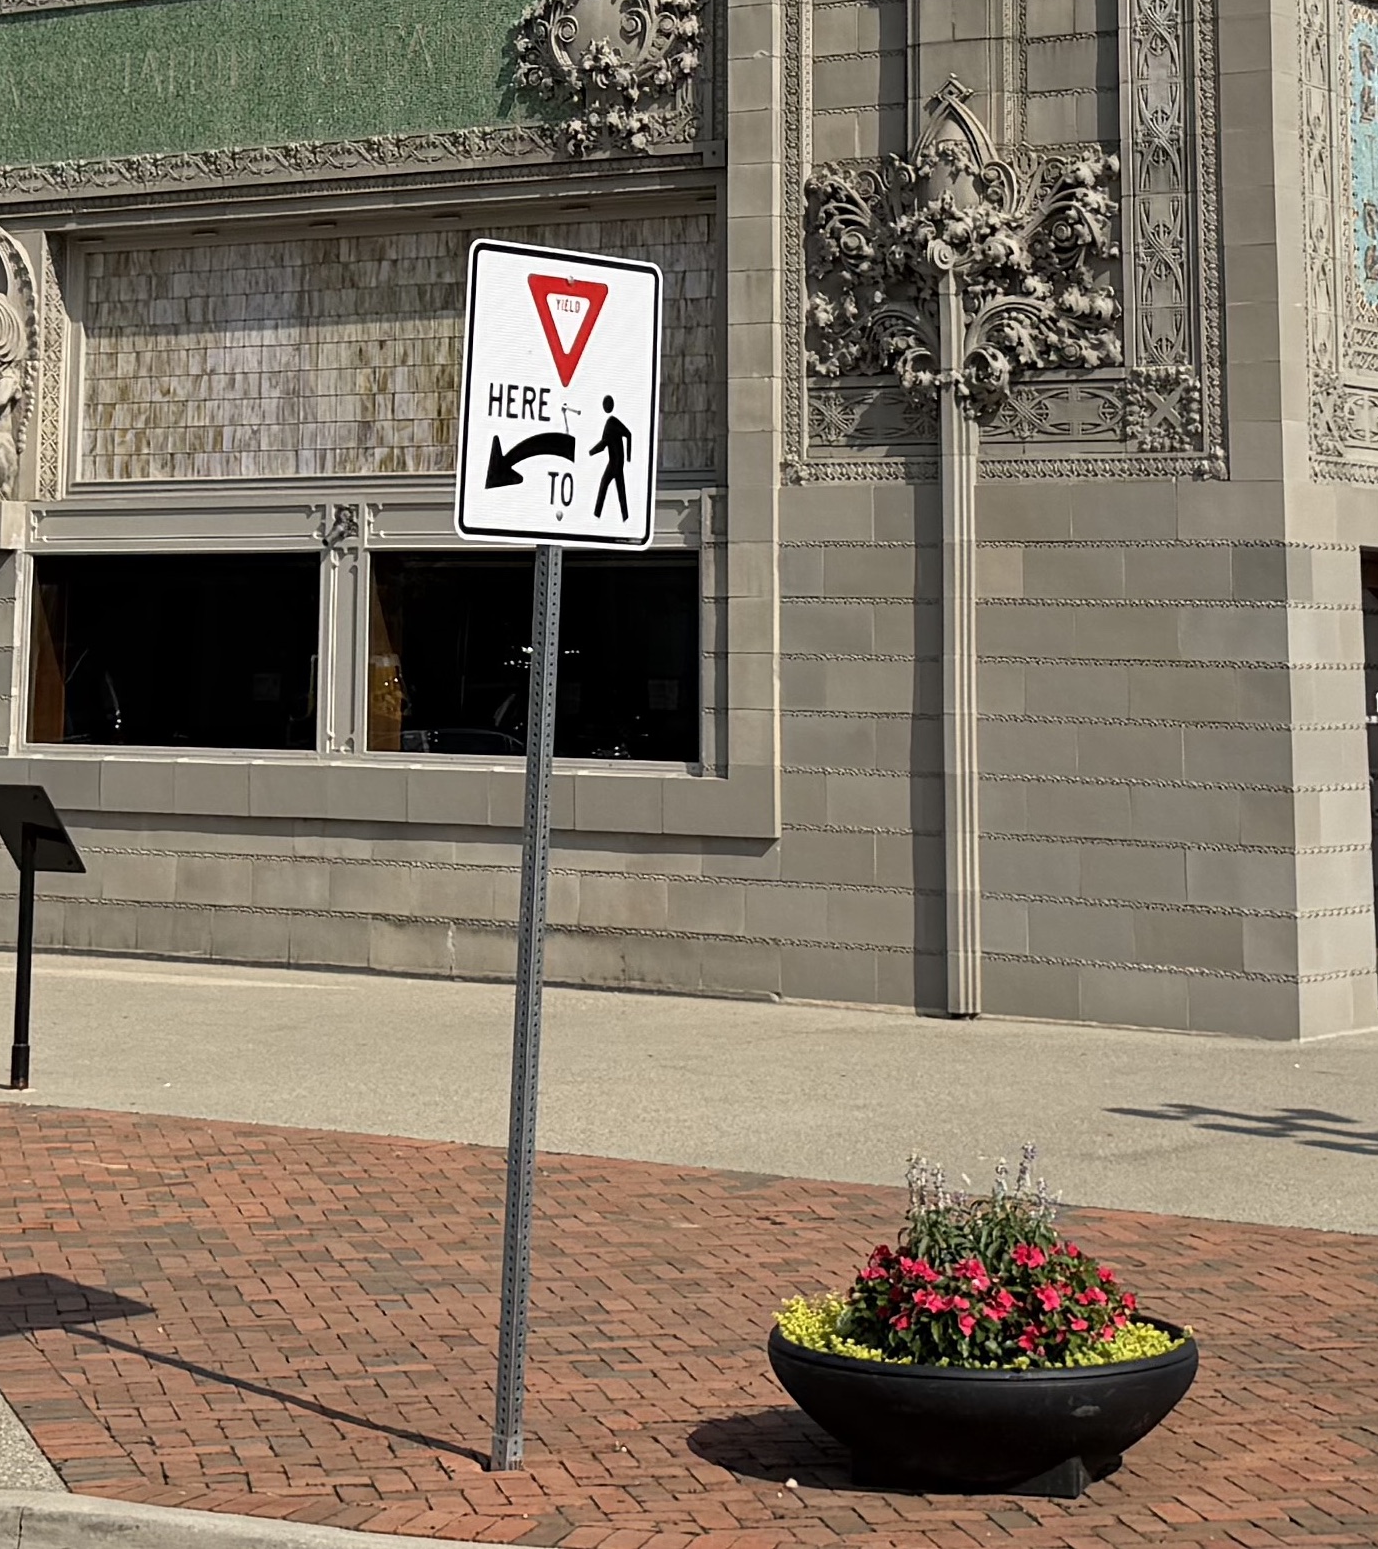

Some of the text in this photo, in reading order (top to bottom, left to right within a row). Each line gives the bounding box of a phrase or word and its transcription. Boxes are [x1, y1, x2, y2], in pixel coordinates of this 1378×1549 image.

[555, 298, 581, 314] YIELD
[488, 383, 551, 422] HERE
[548, 471, 574, 507] TO
